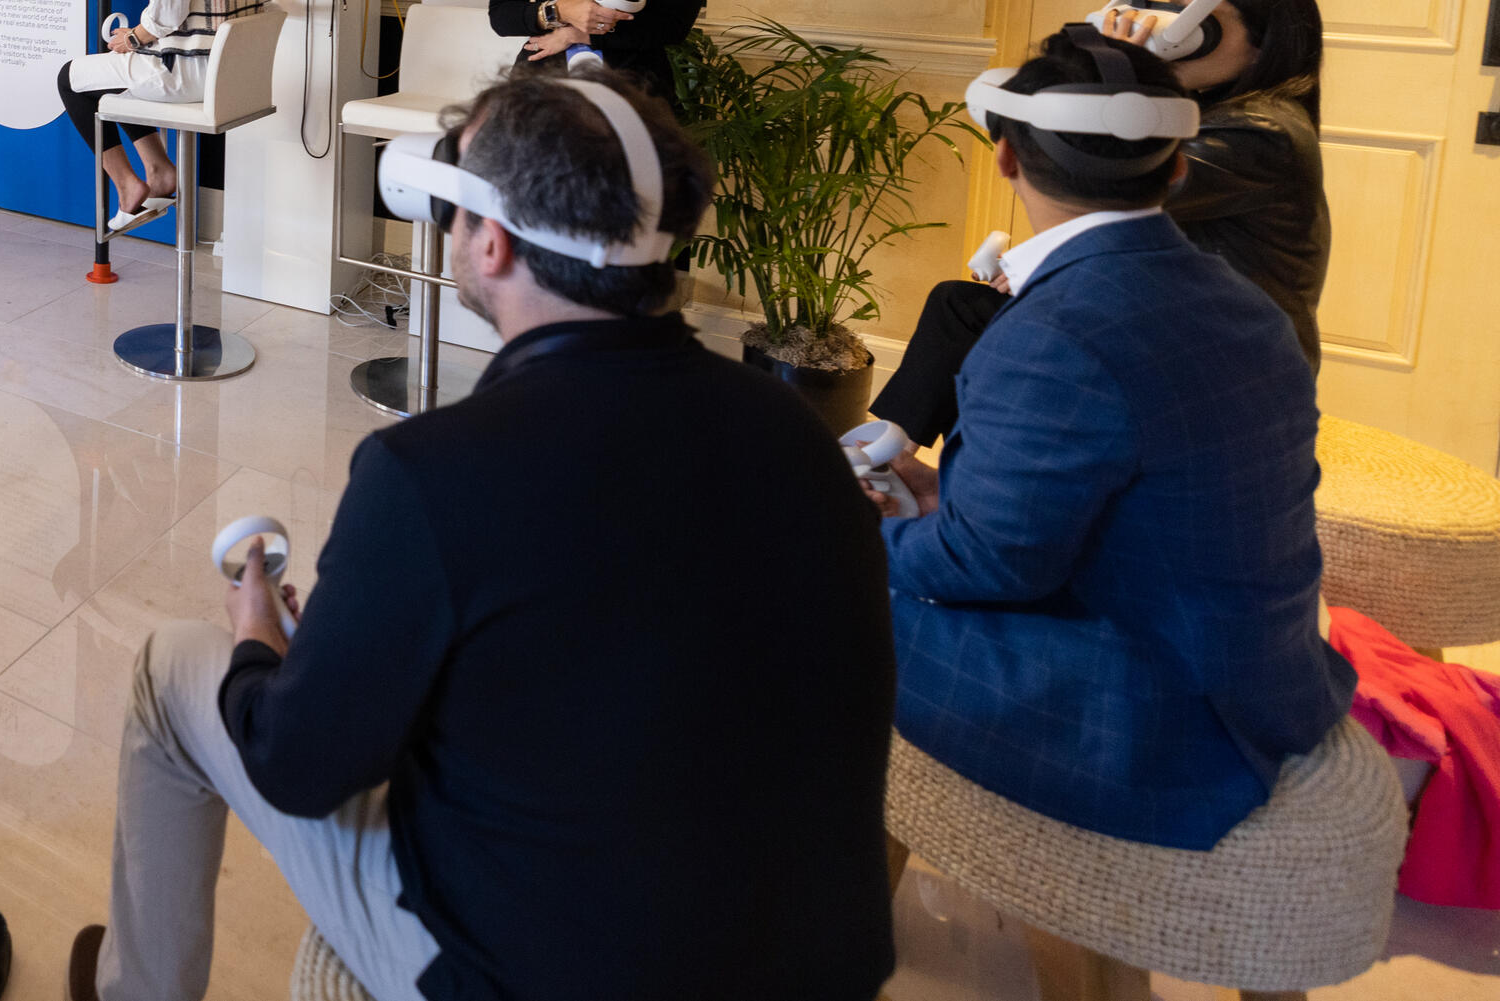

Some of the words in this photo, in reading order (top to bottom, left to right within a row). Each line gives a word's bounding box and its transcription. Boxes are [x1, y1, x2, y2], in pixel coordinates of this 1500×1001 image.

[19, 4, 55, 15] significance
[22, 13, 40, 21] world
[48, 15, 68, 24] digital
[12, 36, 34, 44] energy
[28, 52, 42, 60] both
[43, 46, 66, 56] planted
